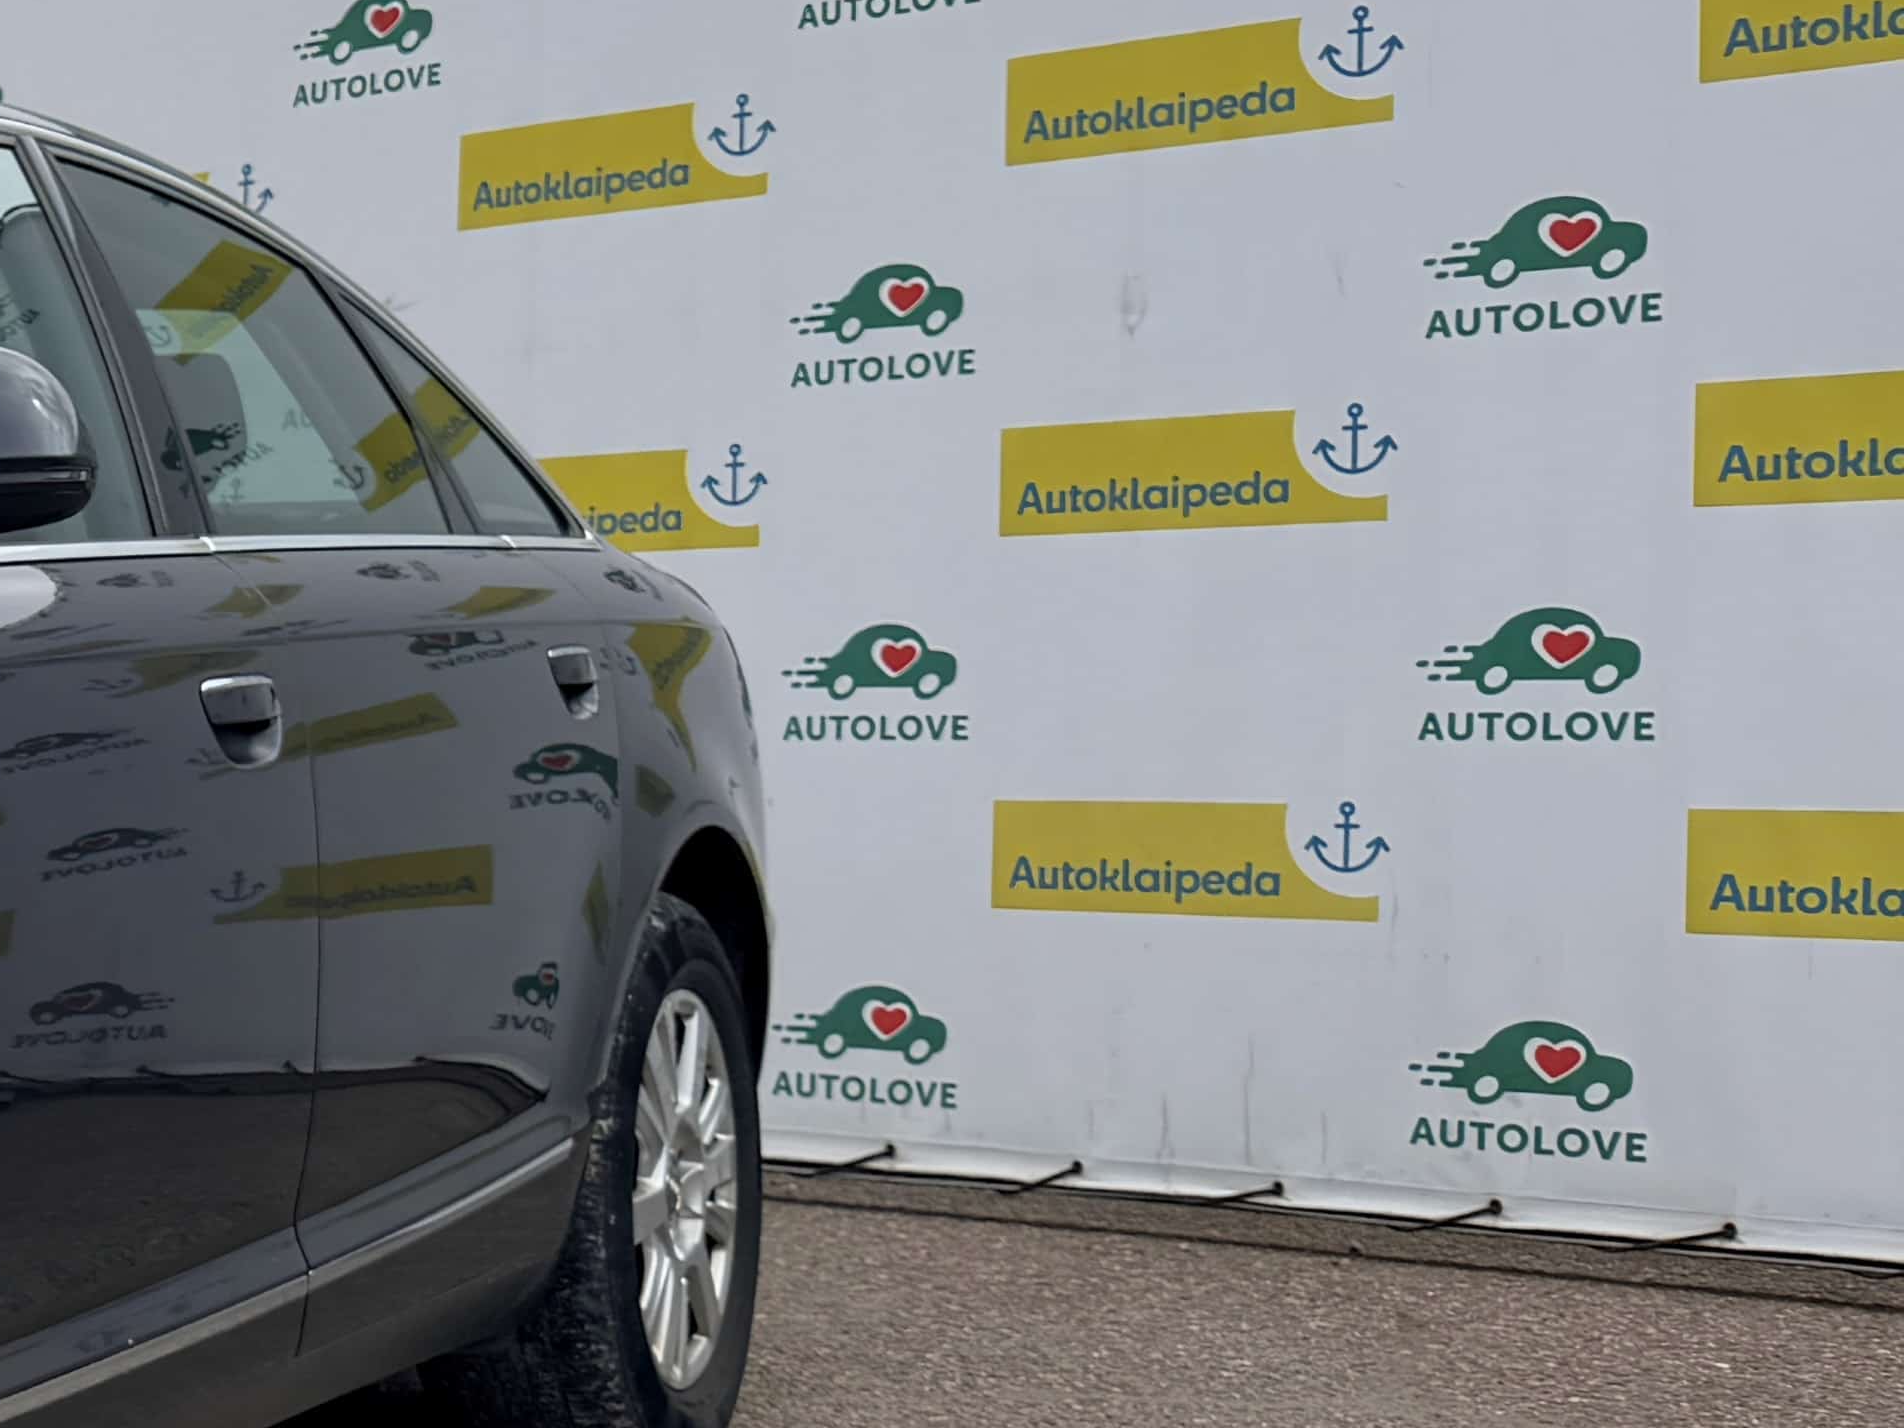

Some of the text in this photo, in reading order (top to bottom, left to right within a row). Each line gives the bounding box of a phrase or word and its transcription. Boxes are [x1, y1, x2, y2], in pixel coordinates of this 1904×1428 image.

[293, 62, 441, 108] AUTOLOVE
[1023, 80, 1296, 144] Autoklaipeda
[473, 158, 690, 212] Autoklaipeda
[1425, 292, 1663, 339] AUTOLOVE
[790, 348, 976, 388] AUTOLOVE
[1017, 470, 1290, 518] Autoklaipeda
[783, 715, 969, 741] AUTOLOVE
[1418, 711, 1655, 742] AUTOLOVE
[1009, 855, 1281, 904] Autoklaipeda
[1710, 873, 1904, 918] Autokla
[772, 1071, 958, 1109] AUTOLOVE
[1409, 1117, 1647, 1163] AUTOLOVE
